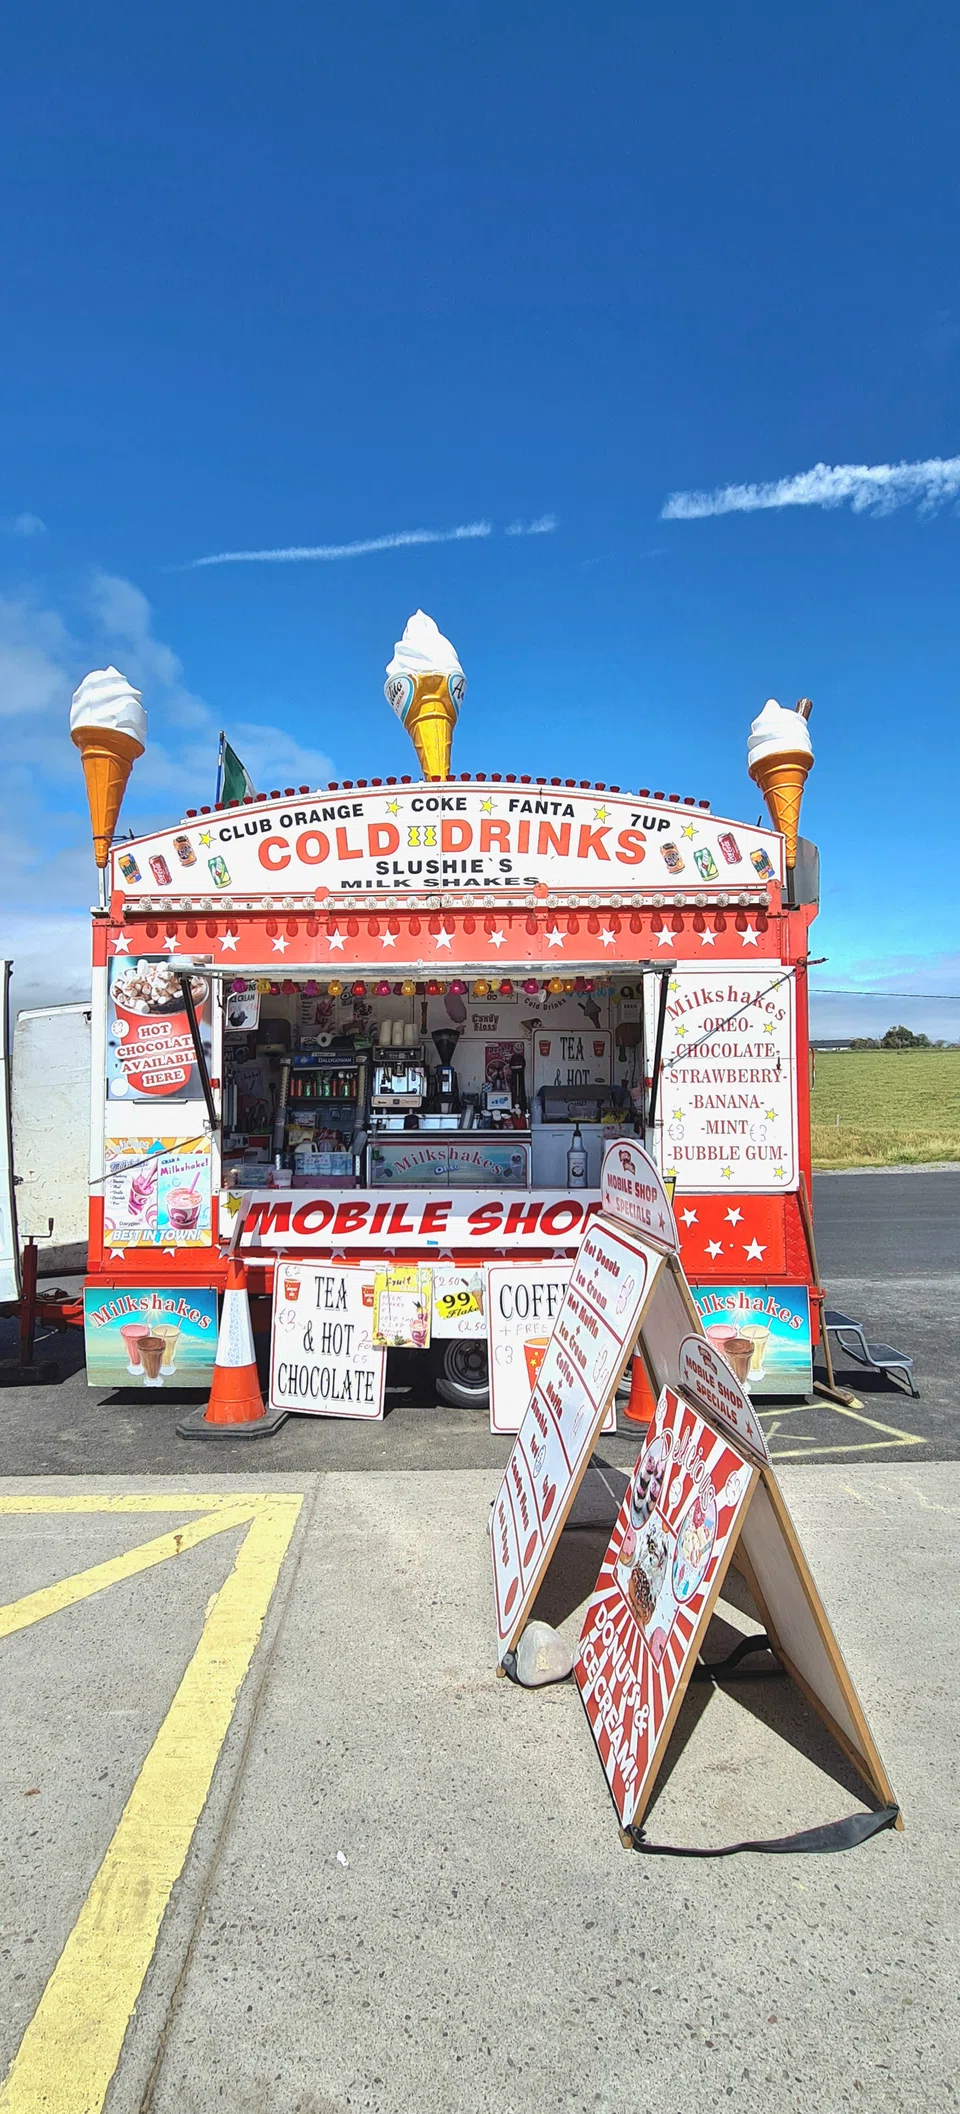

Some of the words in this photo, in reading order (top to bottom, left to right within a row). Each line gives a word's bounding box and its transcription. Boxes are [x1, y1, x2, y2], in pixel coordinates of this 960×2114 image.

[411, 797, 467, 812] COKE
[508, 799, 575, 817] FANTA
[219, 818, 272, 842] CLUB
[279, 803, 364, 828] ORANGE
[630, 813, 671, 832] 7UP
[258, 822, 400, 871] COLD
[441, 819, 647, 865] DRINKS
[341, 879, 411, 888] MILK
[423, 877, 539, 888] SHAKES
[472, 1014, 499, 1024] Candy
[524, 997, 541, 1010] Cold
[543, 998, 567, 1011] Drinks
[665, 986, 786, 1021] Milkshakes
[141, 1024, 169, 1037] HOT
[474, 1023, 498, 1031] Floss
[117, 1036, 194, 1057] CHOCOLAT
[317, 1056, 352, 1064] BALLYGOWAN
[560, 1037, 585, 1061] TEA
[145, 1070, 183, 1085] HERE
[567, 1070, 590, 1086] HOT
[160, 1157, 209, 1176] Milkshake!
[393, 1147, 503, 1175] Milkshakes
[607, 1173, 633, 1195] MOBILE
[634, 1181, 658, 1203] SHOP
[243, 1200, 451, 1234] MOBILE
[616, 1197, 651, 1226] SPECIALS
[112, 1229, 140, 1241] BEST
[142, 1230, 157, 1241] IN
[159, 1229, 201, 1241] TOWN!
[584, 1239, 596, 1258] Hot
[596, 1247, 620, 1277] Donuts
[314, 1276, 349, 1310] TEA
[385, 1276, 412, 1288] Fruit
[575, 1268, 586, 1287] Ice
[587, 1280, 607, 1310] Cream
[90, 1293, 212, 1329] Milkshakes
[442, 1291, 470, 1309] 99
[567, 1293, 579, 1314] Hot
[578, 1305, 598, 1339] Muffin
[695, 1292, 803, 1329] ilkshakes
[303, 1320, 314, 1353] &
[321, 1322, 354, 1356] HOT
[559, 1320, 569, 1341] Ice
[569, 1334, 587, 1369] Cream
[278, 1362, 375, 1403] CHOCOLATE
[556, 1351, 574, 1388] Coffee
[685, 1354, 715, 1387] MOBILE
[717, 1381, 743, 1410] SHOP
[531, 1396, 548, 1438] Slushie
[546, 1380, 562, 1420] Muffin
[695, 1379, 738, 1425] SPECIALS
[511, 1455, 523, 1498] Candy
[660, 1425, 715, 1512] Delicious
[594, 1602, 640, 1707] DONUTS
[634, 1703, 650, 1737] &
[578, 1634, 600, 1685] ICE
[594, 1675, 638, 1792] CREAM!
